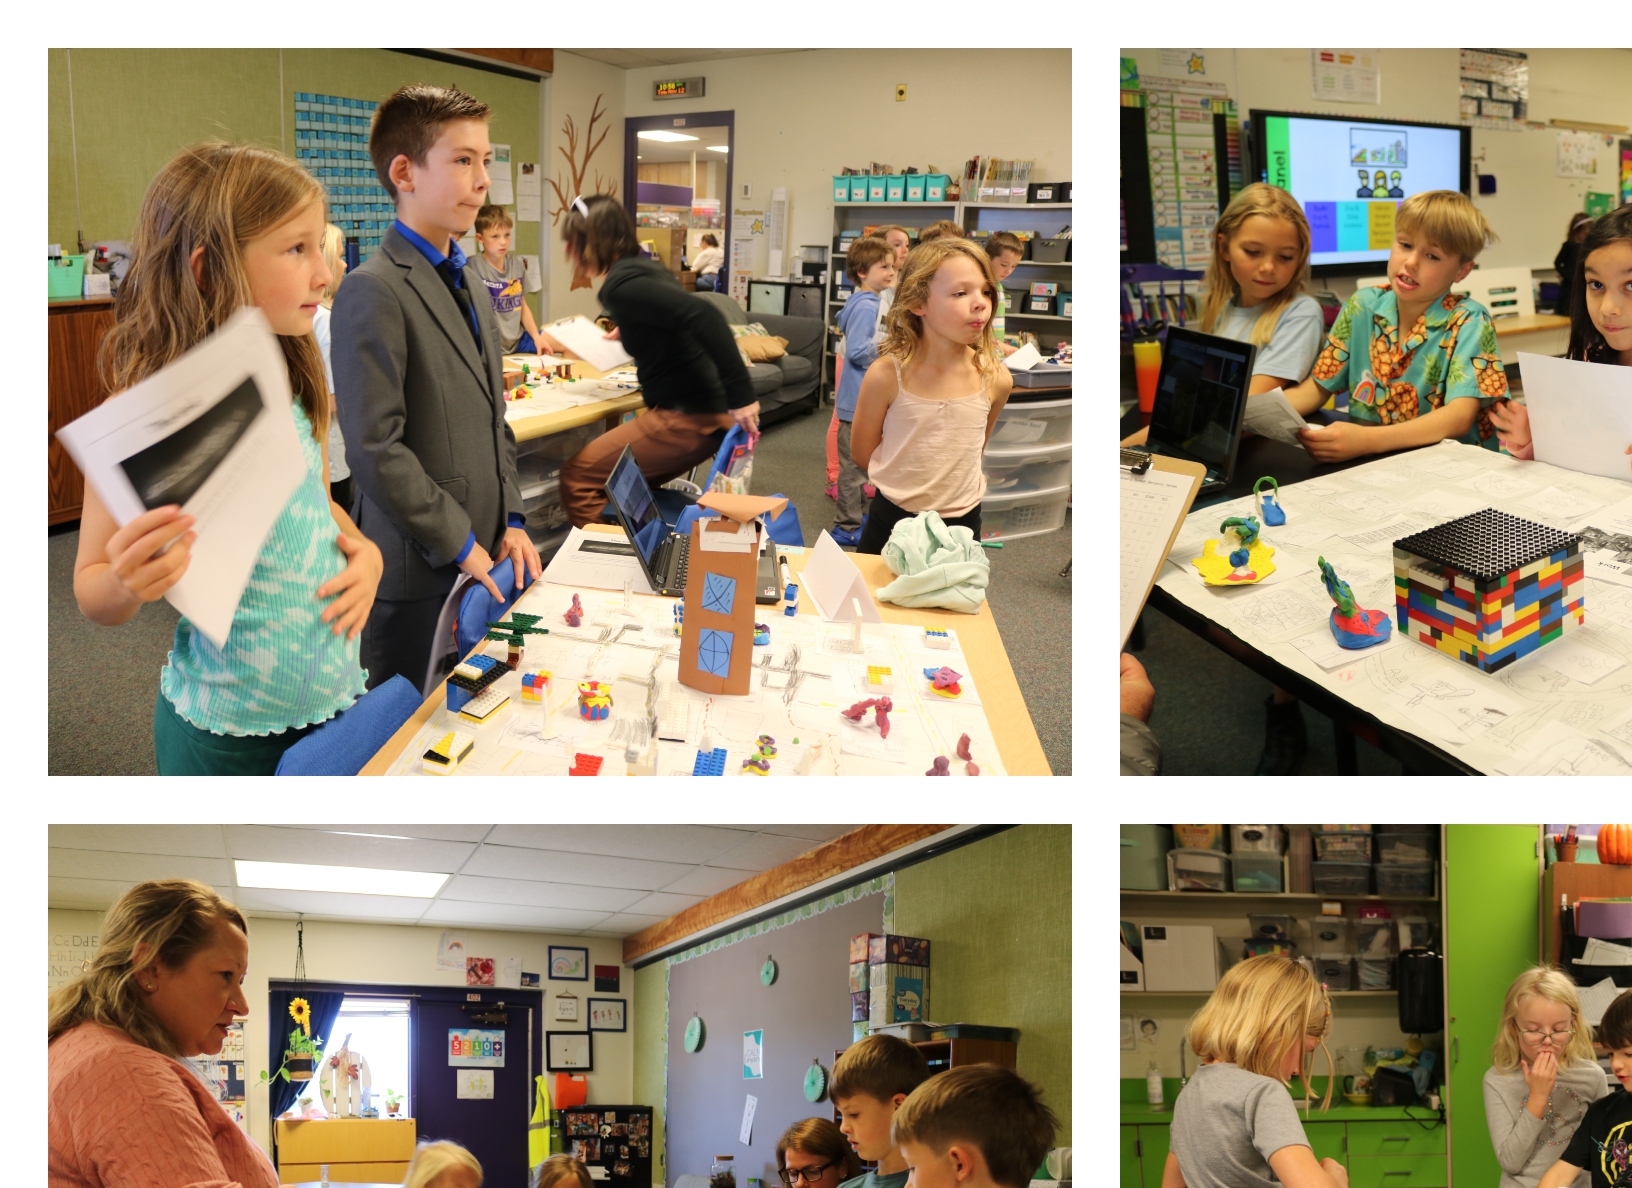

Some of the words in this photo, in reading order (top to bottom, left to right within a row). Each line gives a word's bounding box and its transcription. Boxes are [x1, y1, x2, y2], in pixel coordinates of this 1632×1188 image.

[1273, 151, 1286, 188] anel
[53, 935, 69, 946] Cc
[72, 936, 89, 947] Dd
[52, 965, 69, 976] Nn
[454, 1042, 460, 1050] 5
[464, 1042, 469, 1050] 2
[475, 1042, 480, 1050] 1
[484, 1042, 490, 1050] 0
